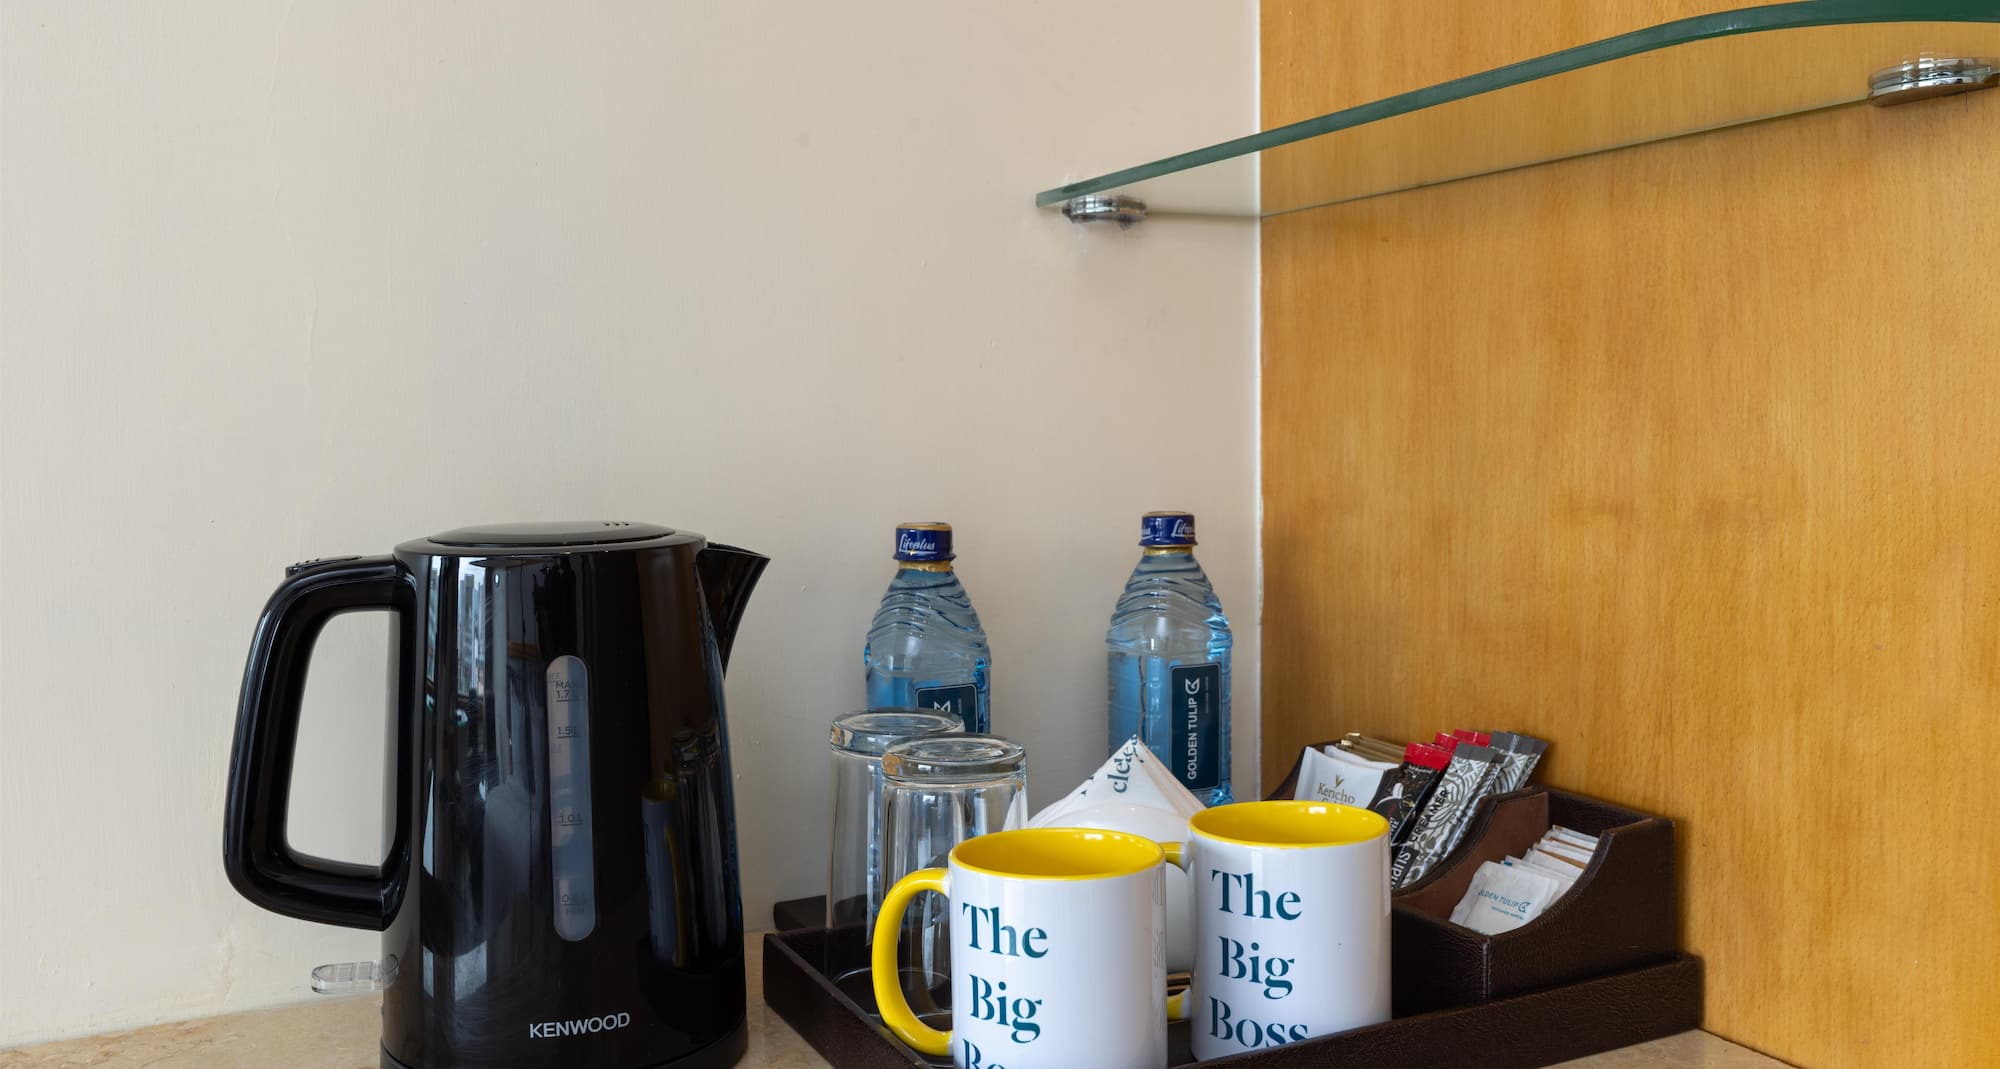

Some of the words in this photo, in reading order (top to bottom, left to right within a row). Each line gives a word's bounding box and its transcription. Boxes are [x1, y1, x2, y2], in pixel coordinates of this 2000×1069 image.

[1188, 698, 1198, 730] TULIP
[1187, 733, 1198, 780] GOLDEN
[1212, 869, 1302, 921] The
[963, 902, 1049, 958] The
[1219, 935, 1295, 1000] Big
[529, 1012, 631, 1039] KENWOOD
[969, 973, 1042, 1044] Big
